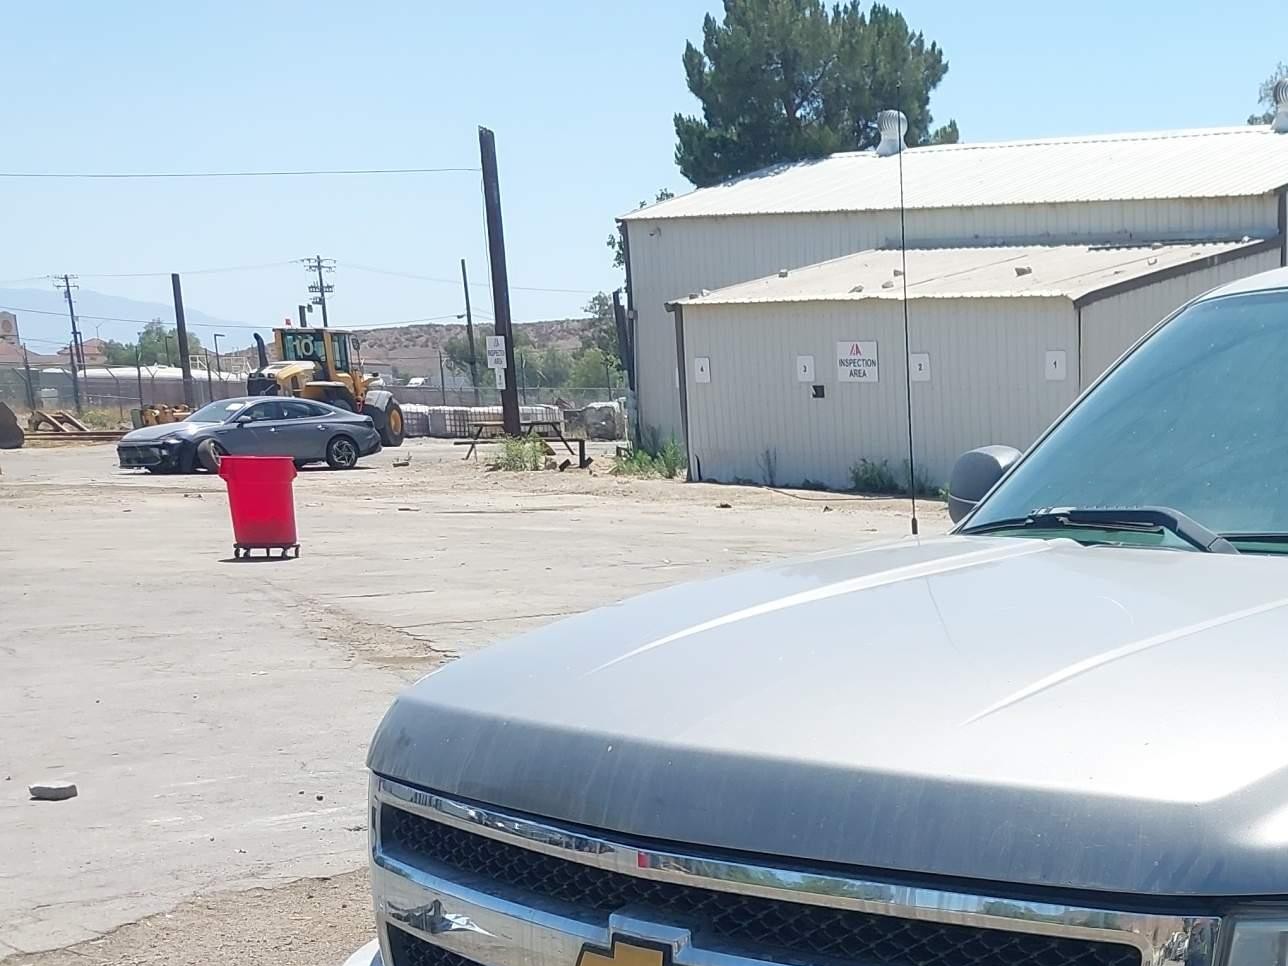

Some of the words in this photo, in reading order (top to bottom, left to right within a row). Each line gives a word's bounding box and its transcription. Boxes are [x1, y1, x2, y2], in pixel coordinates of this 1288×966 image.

[292, 336, 314, 358] 10
[838, 358, 877, 368] INSPECTION
[849, 368, 867, 378] AREA
